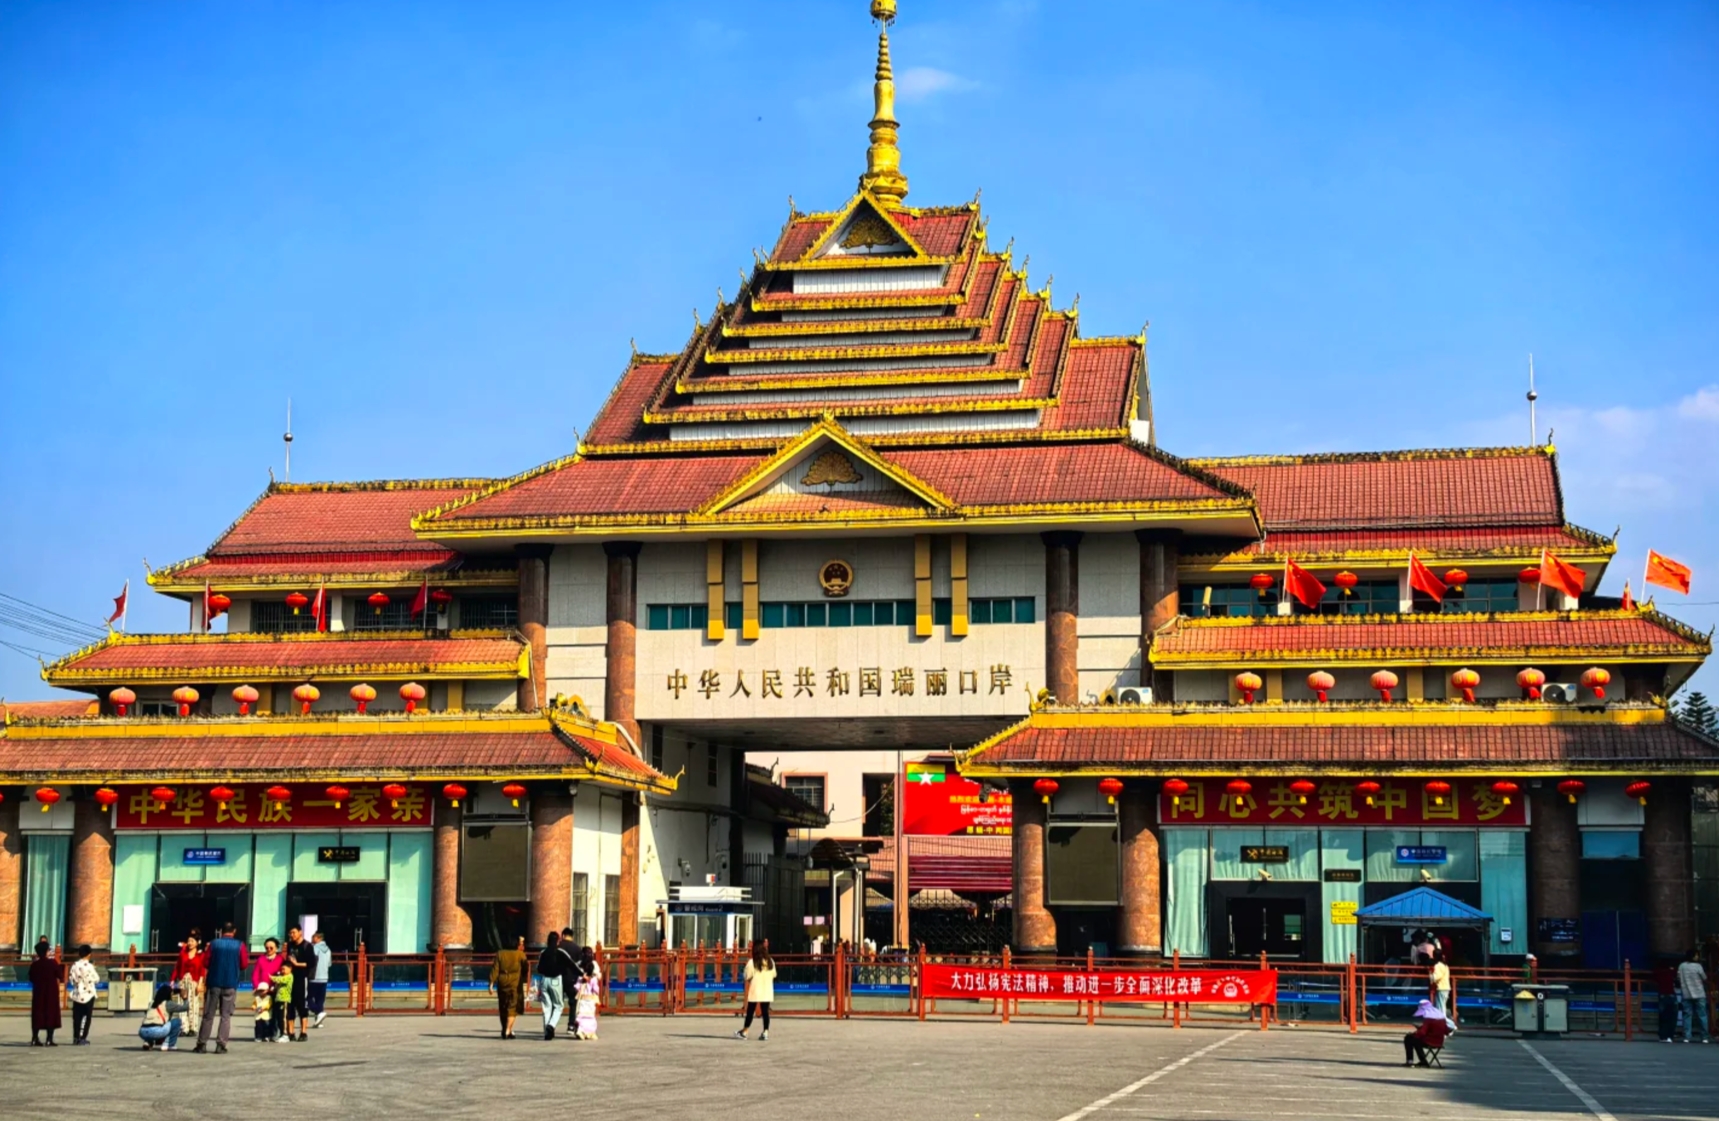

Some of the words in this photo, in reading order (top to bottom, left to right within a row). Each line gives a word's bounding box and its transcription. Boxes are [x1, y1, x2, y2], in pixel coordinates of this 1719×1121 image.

[667, 663, 1013, 700] 中华人民共和国瑞丽口岸
[129, 787, 425, 824] 中华民族一家亲
[1170, 781, 1509, 820] 同心共筑中国梦
